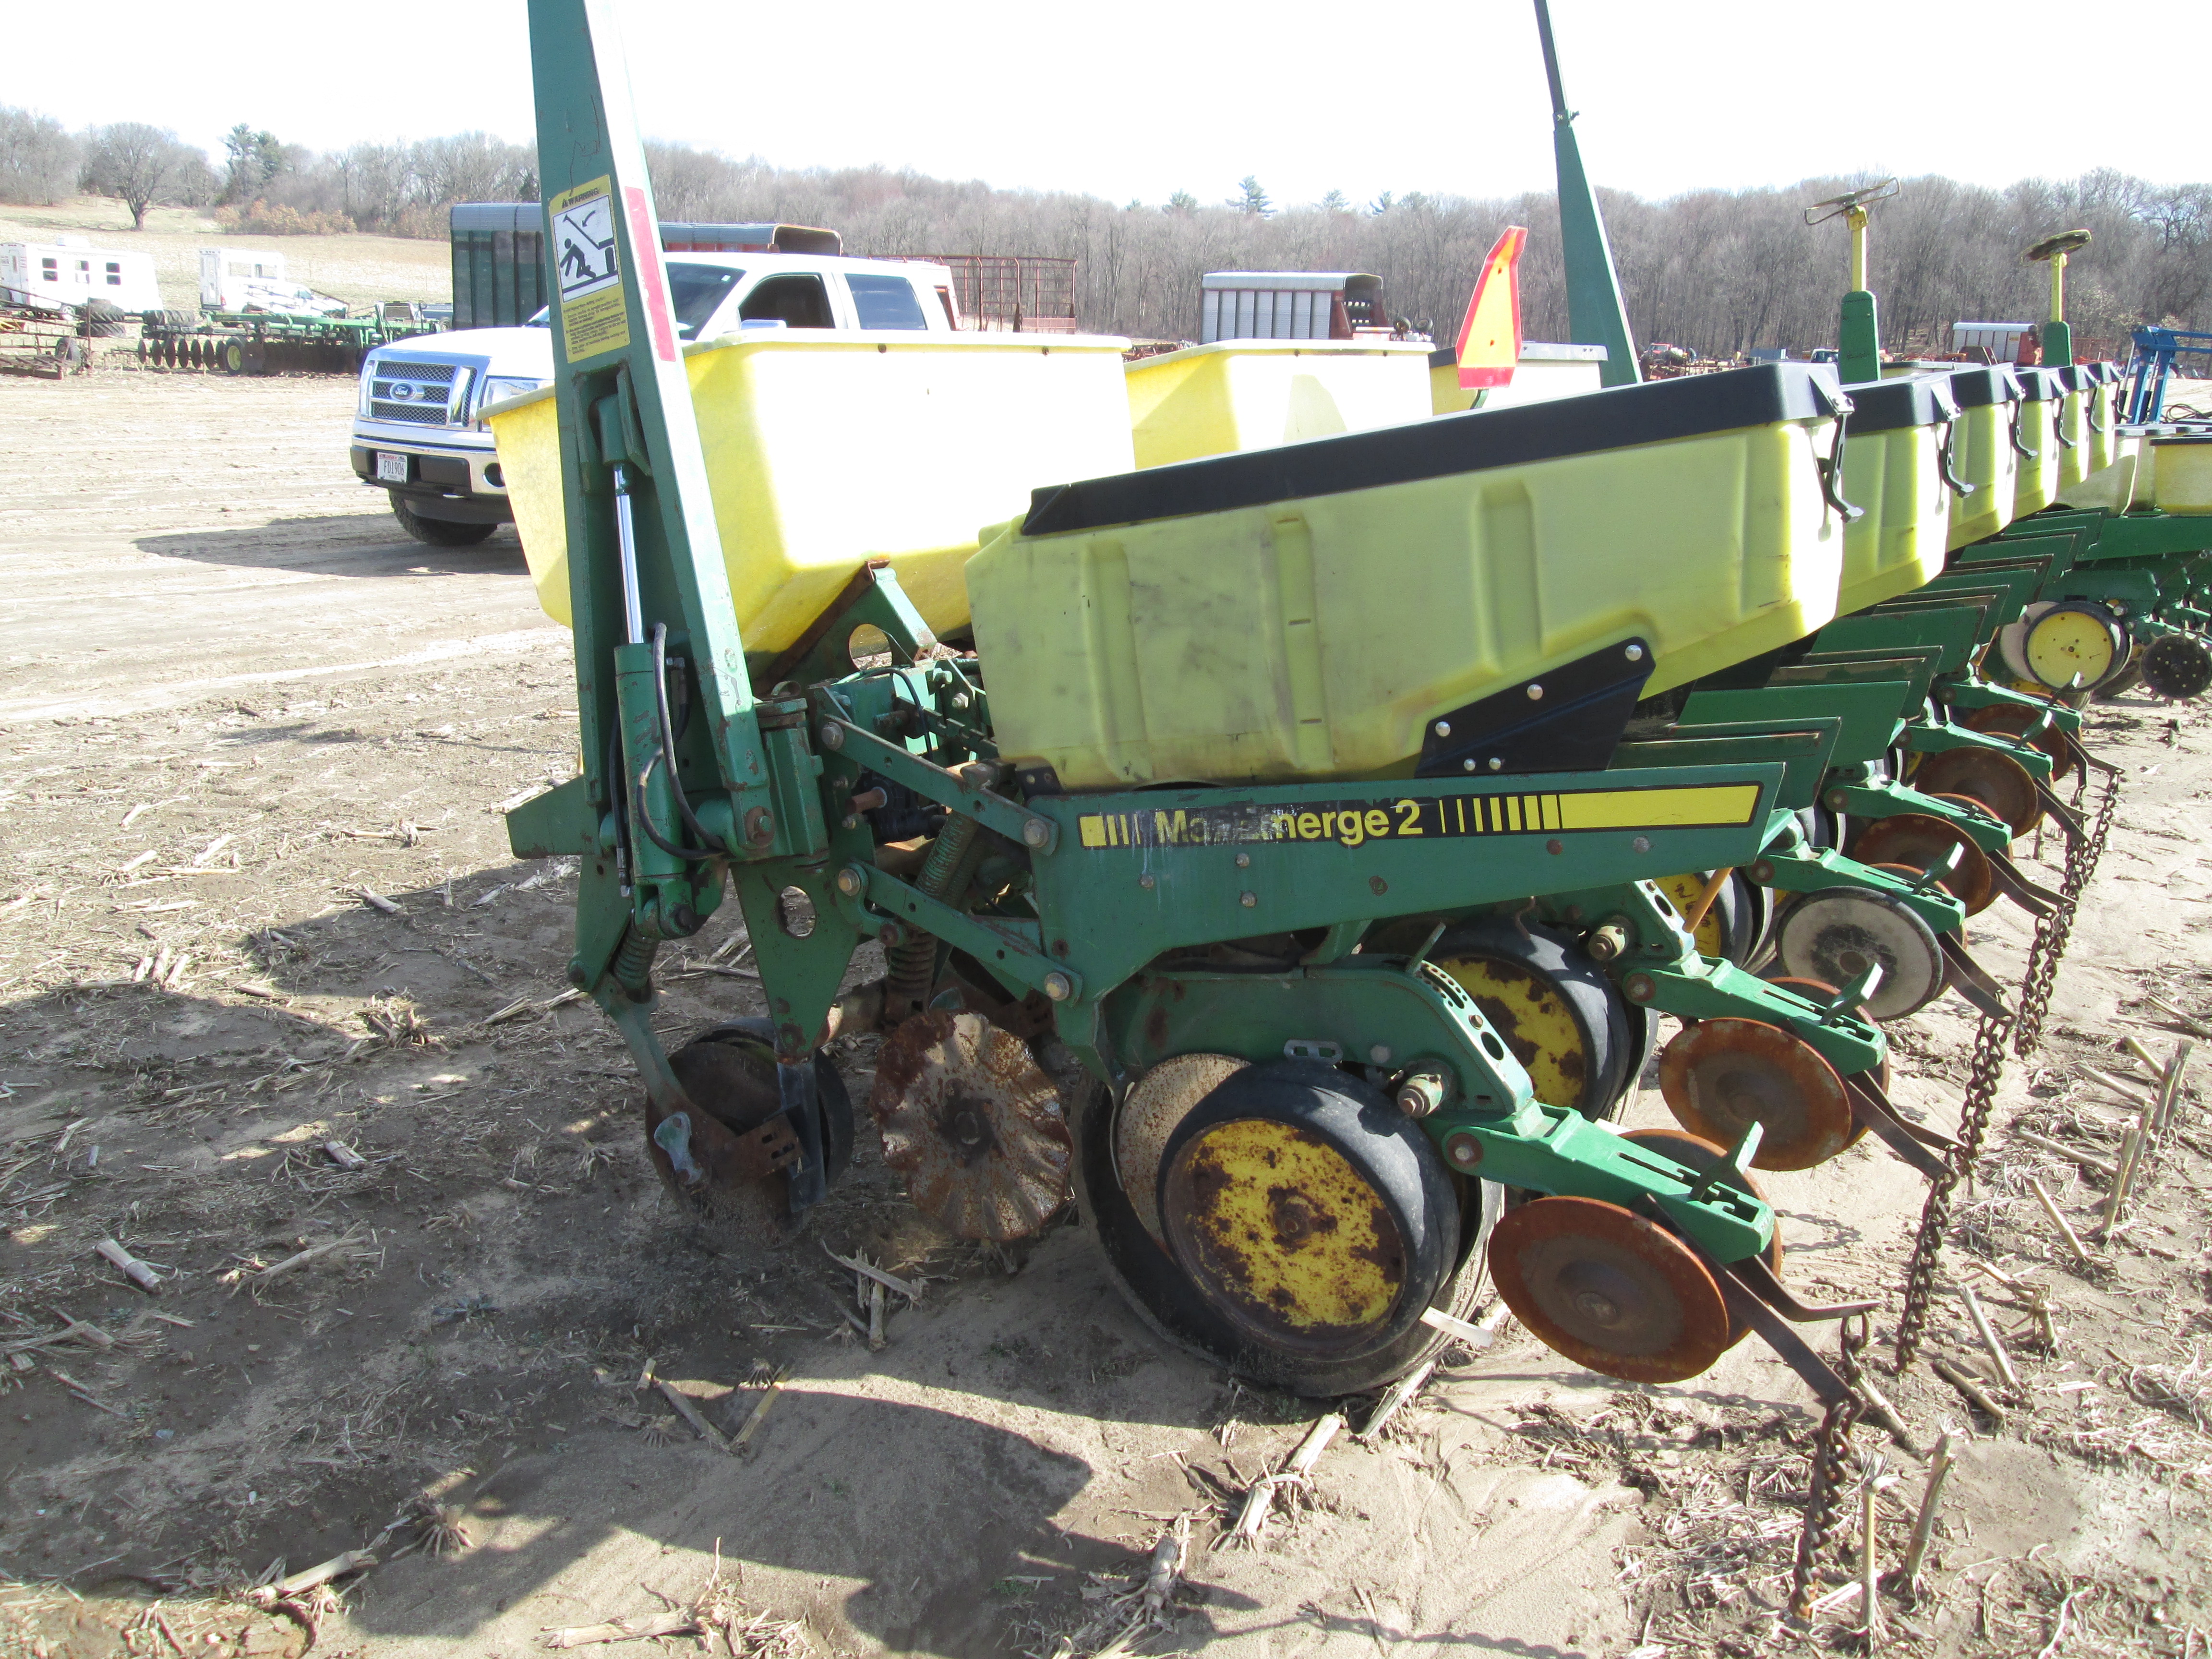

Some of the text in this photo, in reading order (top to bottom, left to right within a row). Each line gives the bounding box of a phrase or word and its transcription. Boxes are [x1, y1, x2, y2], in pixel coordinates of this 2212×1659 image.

[568, 187, 600, 205] WARNING
[395, 385, 409, 396] Ford
[1395, 799, 1423, 835] 2
